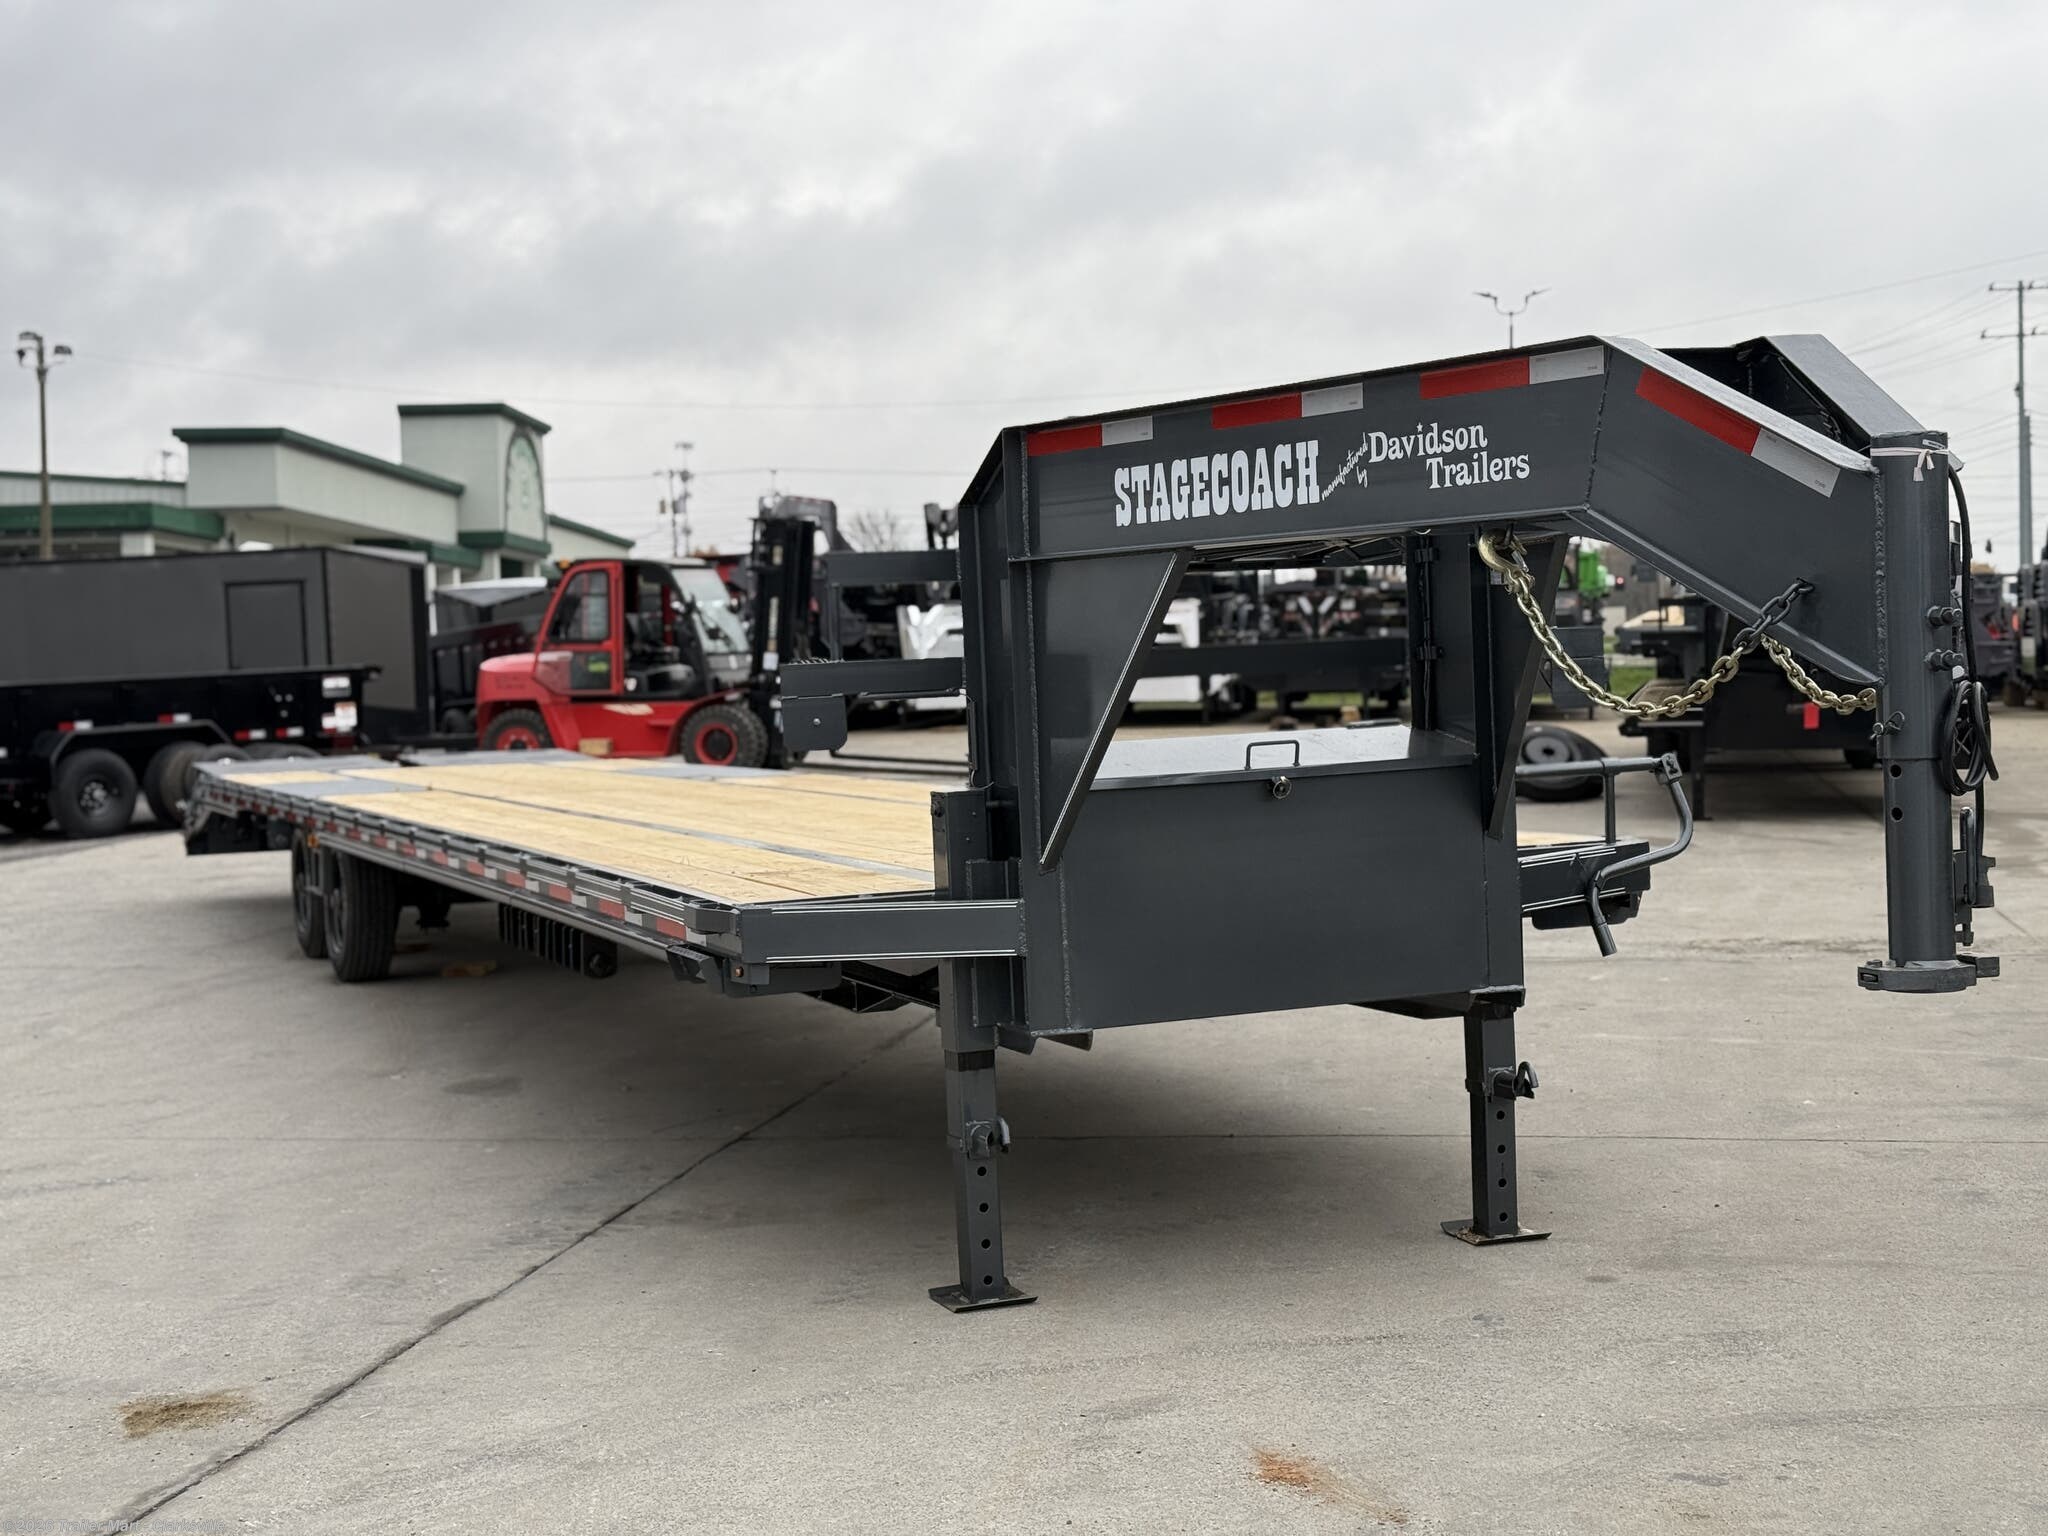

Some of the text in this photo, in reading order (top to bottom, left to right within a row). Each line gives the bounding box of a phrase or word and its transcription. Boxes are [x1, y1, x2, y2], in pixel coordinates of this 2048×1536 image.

[1367, 422, 1488, 463] Davidson
[1114, 439, 1320, 527] STAGECOACH
[1321, 432, 1368, 500] manufactured
[1356, 466, 1368, 488] by
[1426, 451, 1530, 489] Trailers
